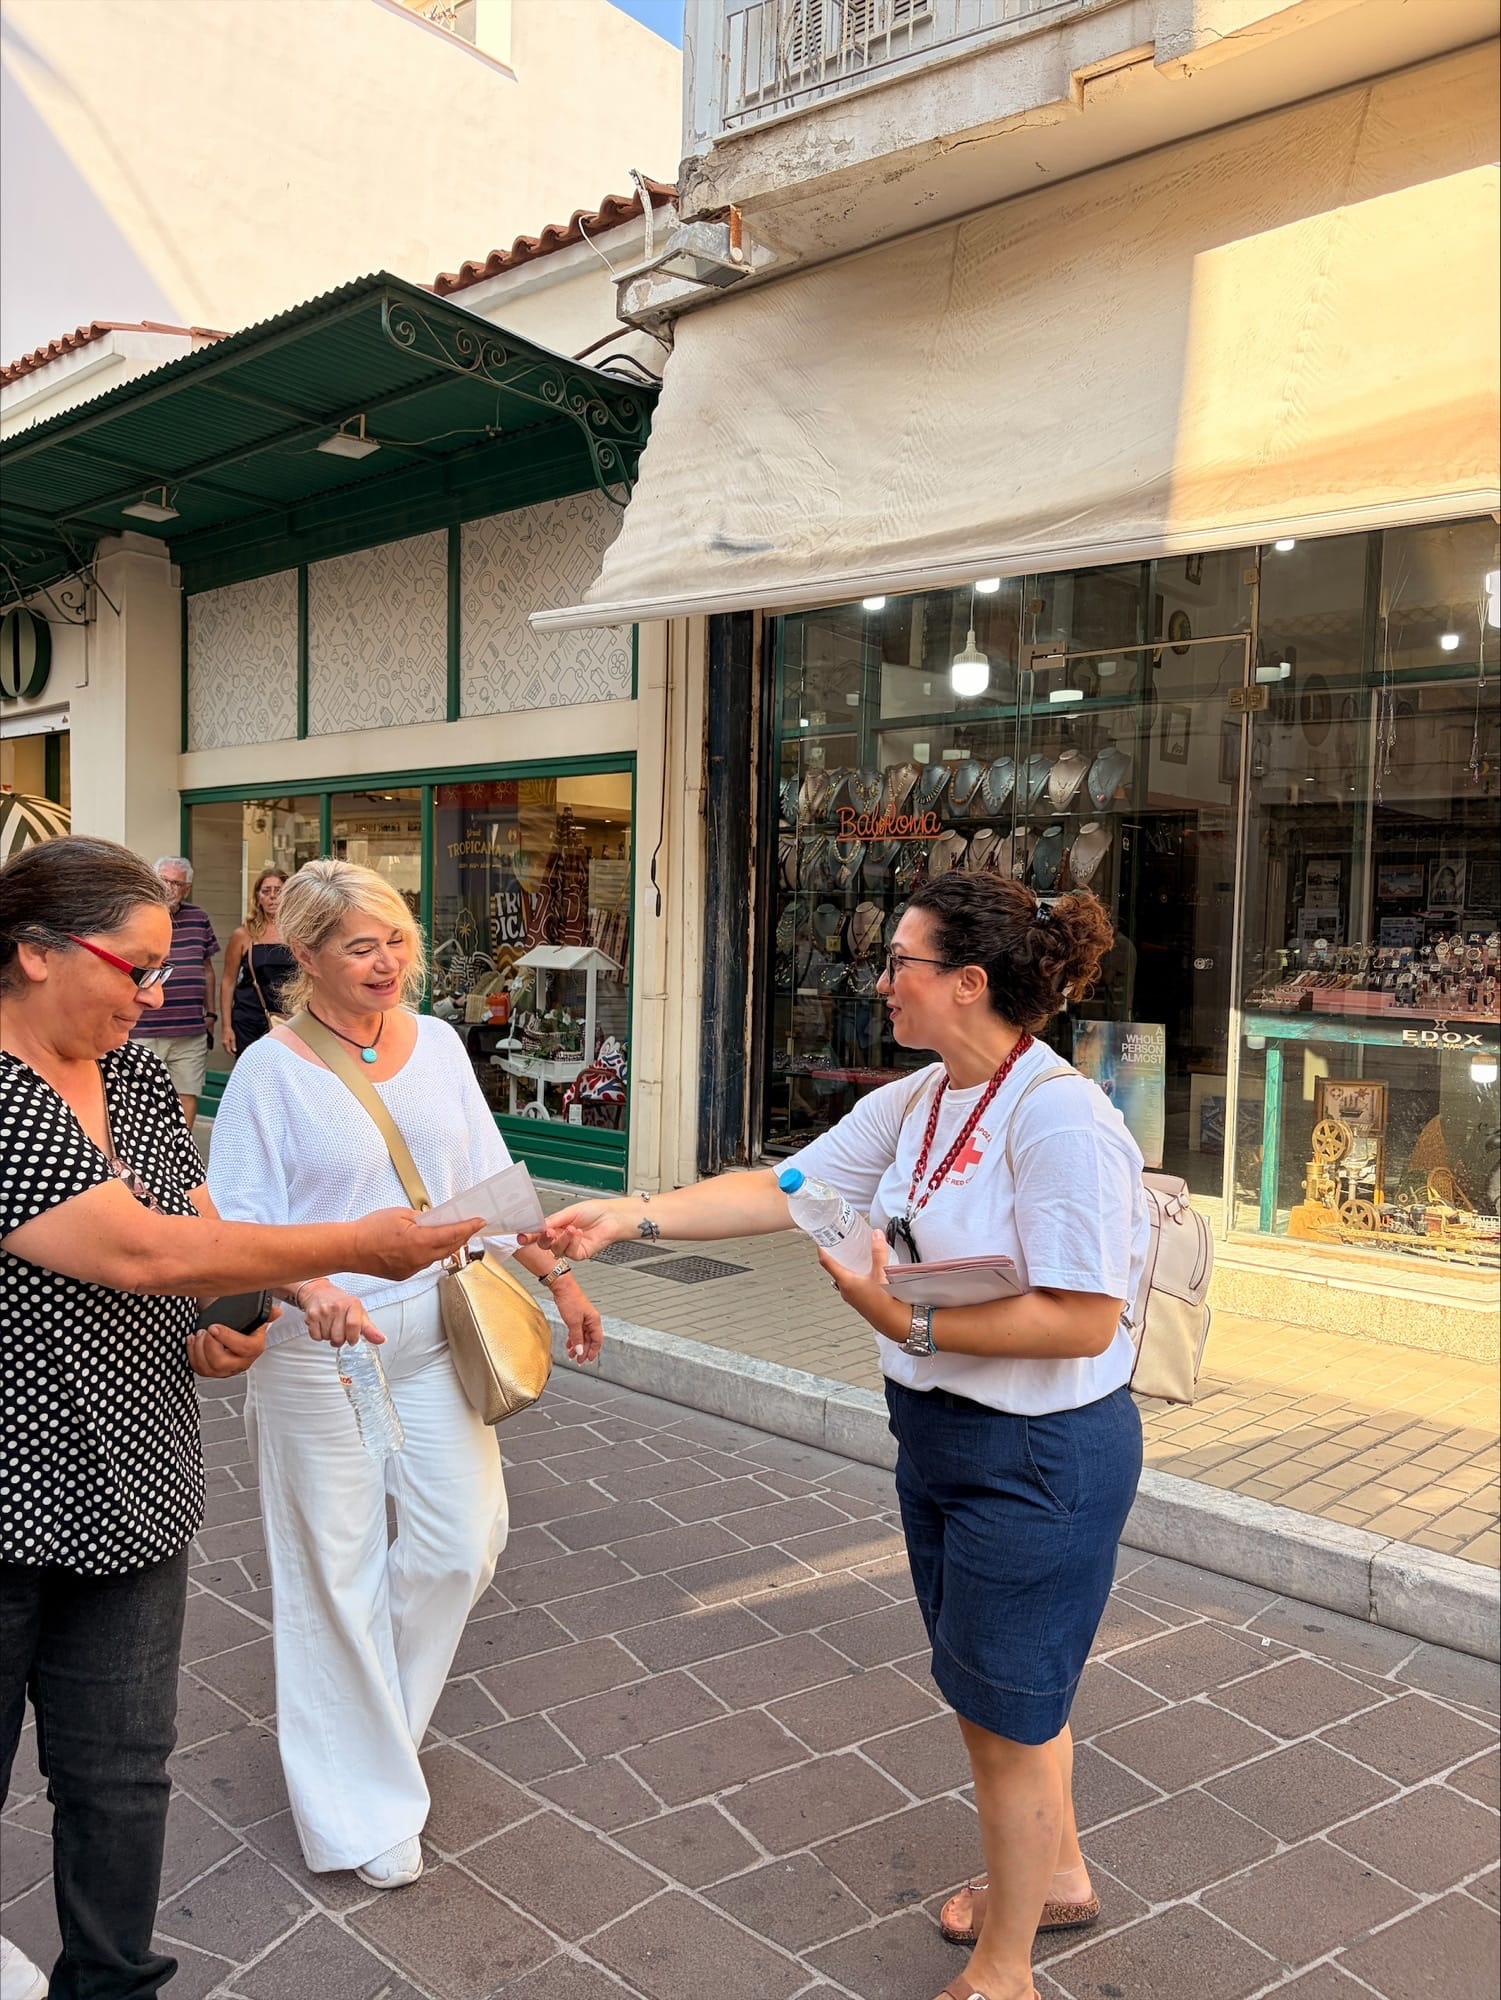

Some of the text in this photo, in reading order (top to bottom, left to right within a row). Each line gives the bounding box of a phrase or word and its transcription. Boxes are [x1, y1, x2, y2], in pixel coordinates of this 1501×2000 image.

[1155, 1026, 1163, 1035] A
[1126, 1034, 1164, 1044] WHOLE
[1402, 1029, 1483, 1046] EDOX
[1121, 1043, 1164, 1054] PERSON
[1120, 1053, 1163, 1064] ALMOST
